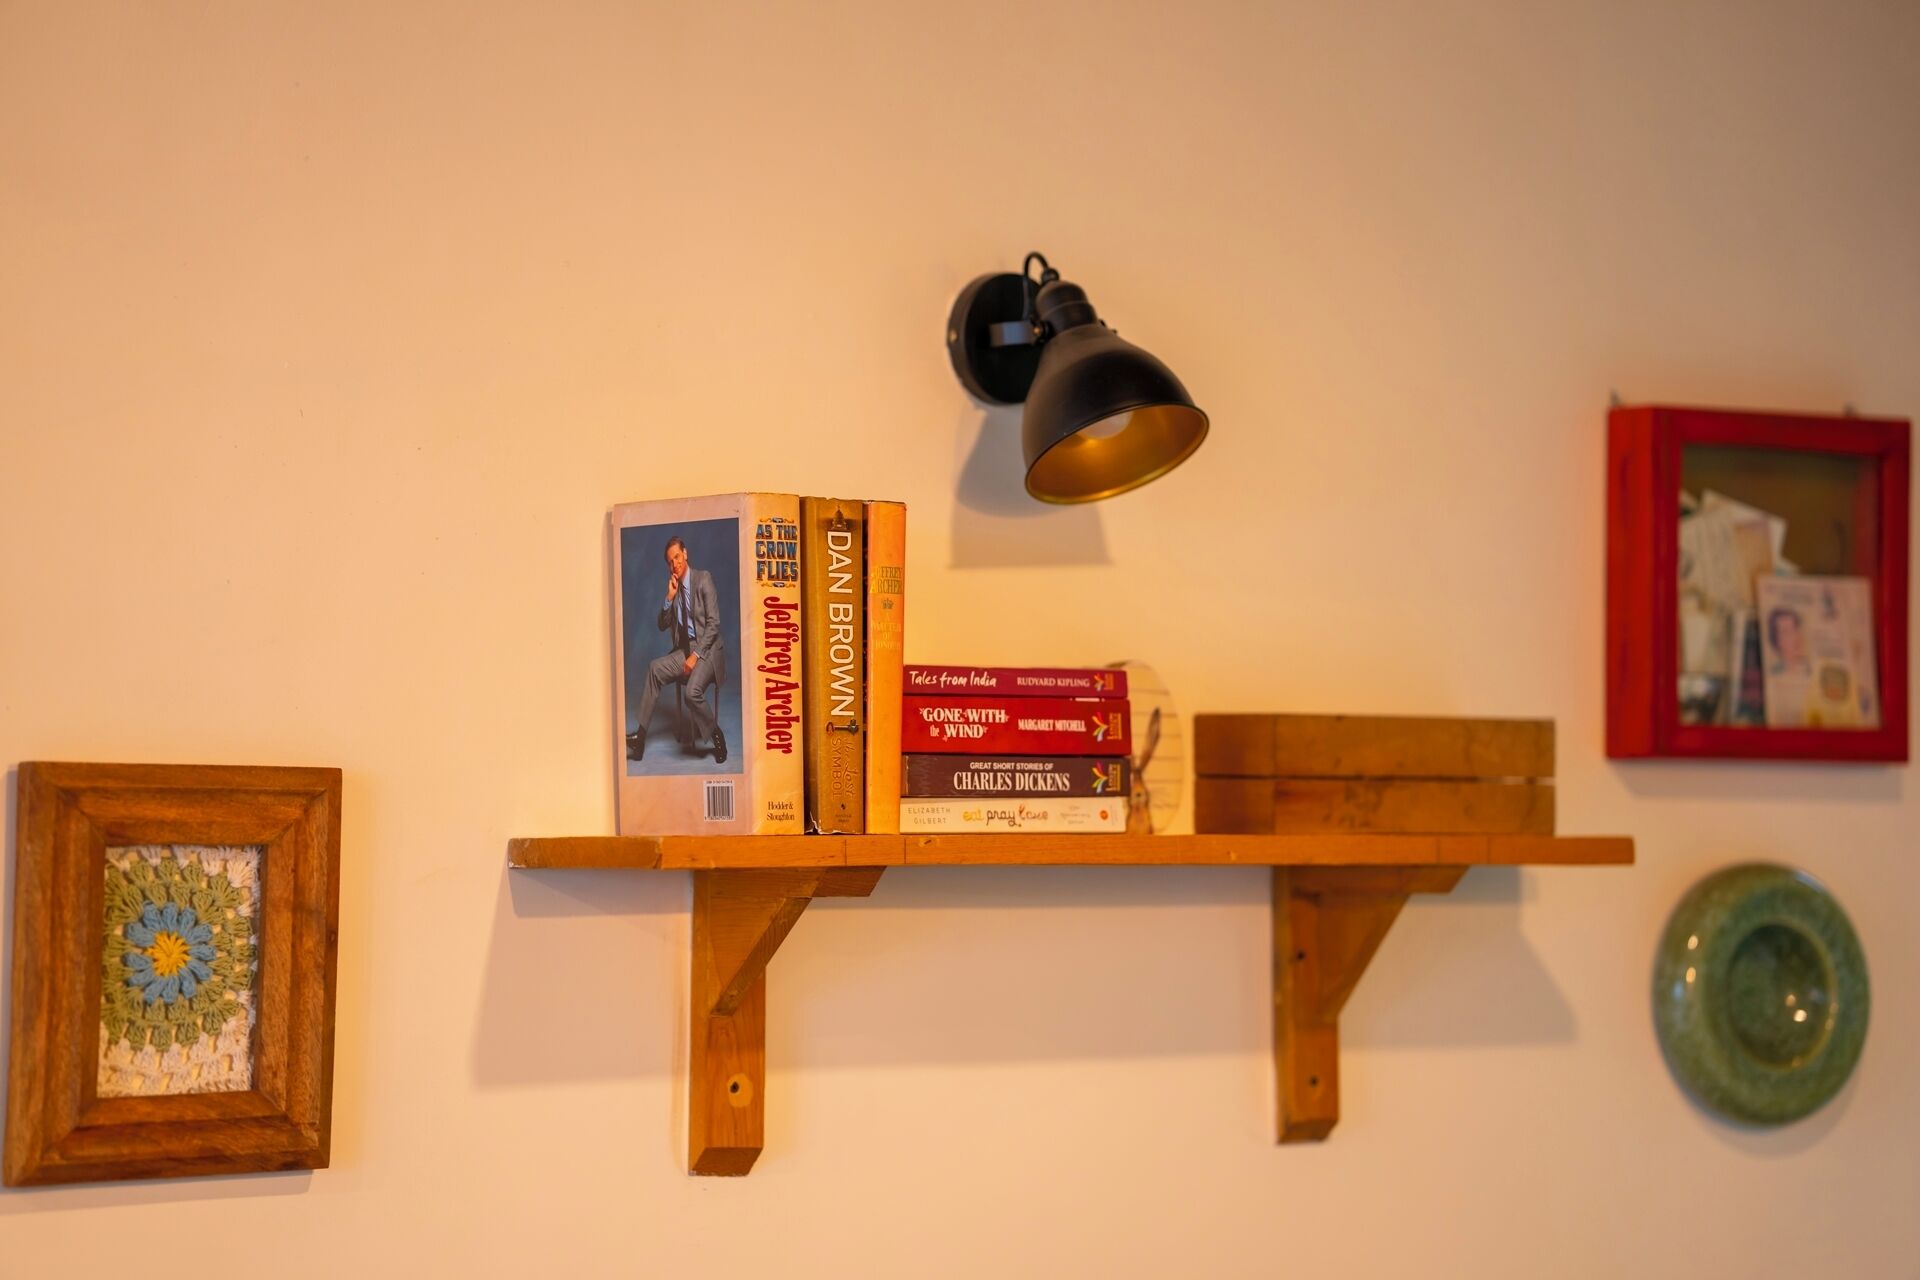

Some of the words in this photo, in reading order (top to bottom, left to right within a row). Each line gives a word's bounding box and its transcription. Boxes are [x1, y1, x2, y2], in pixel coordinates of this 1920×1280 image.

[756, 524, 773, 539] AS
[776, 525, 798, 540] THE
[756, 541, 798, 560] CROW
[756, 560, 799, 581] FLIES
[827, 531, 853, 593] DAN
[757, 596, 800, 677] Jeffrey
[828, 603, 855, 716] BROWN
[909, 671, 937, 685] Tales
[939, 671, 968, 688] from
[970, 671, 997, 687] India
[1017, 677, 1056, 687] RUDYARD
[1057, 678, 1090, 688] KIPLING
[765, 678, 801, 754] Archer
[922, 707, 963, 722] GONE
[966, 708, 1006, 723] WITH
[929, 724, 940, 737] the
[944, 723, 984, 738] WIND
[1018, 719, 1054, 731] MARGARET
[1055, 720, 1087, 732] MITCHELL
[832, 738, 843, 800] SYMBOL
[969, 762, 992, 770] GREAT
[992, 762, 1015, 770] SHORT
[1016, 763, 1043, 771] STORIES
[1044, 763, 1054, 771] OF
[953, 771, 1012, 790] CHARLES
[1015, 773, 1070, 791] DICKENS
[767, 801, 789, 810] Hodder
[766, 812, 795, 821] Stoughton
[913, 816, 947, 825] GILBERT
[962, 808, 984, 821] eat
[986, 809, 1018, 827] pray
[1018, 803, 1049, 821] love
